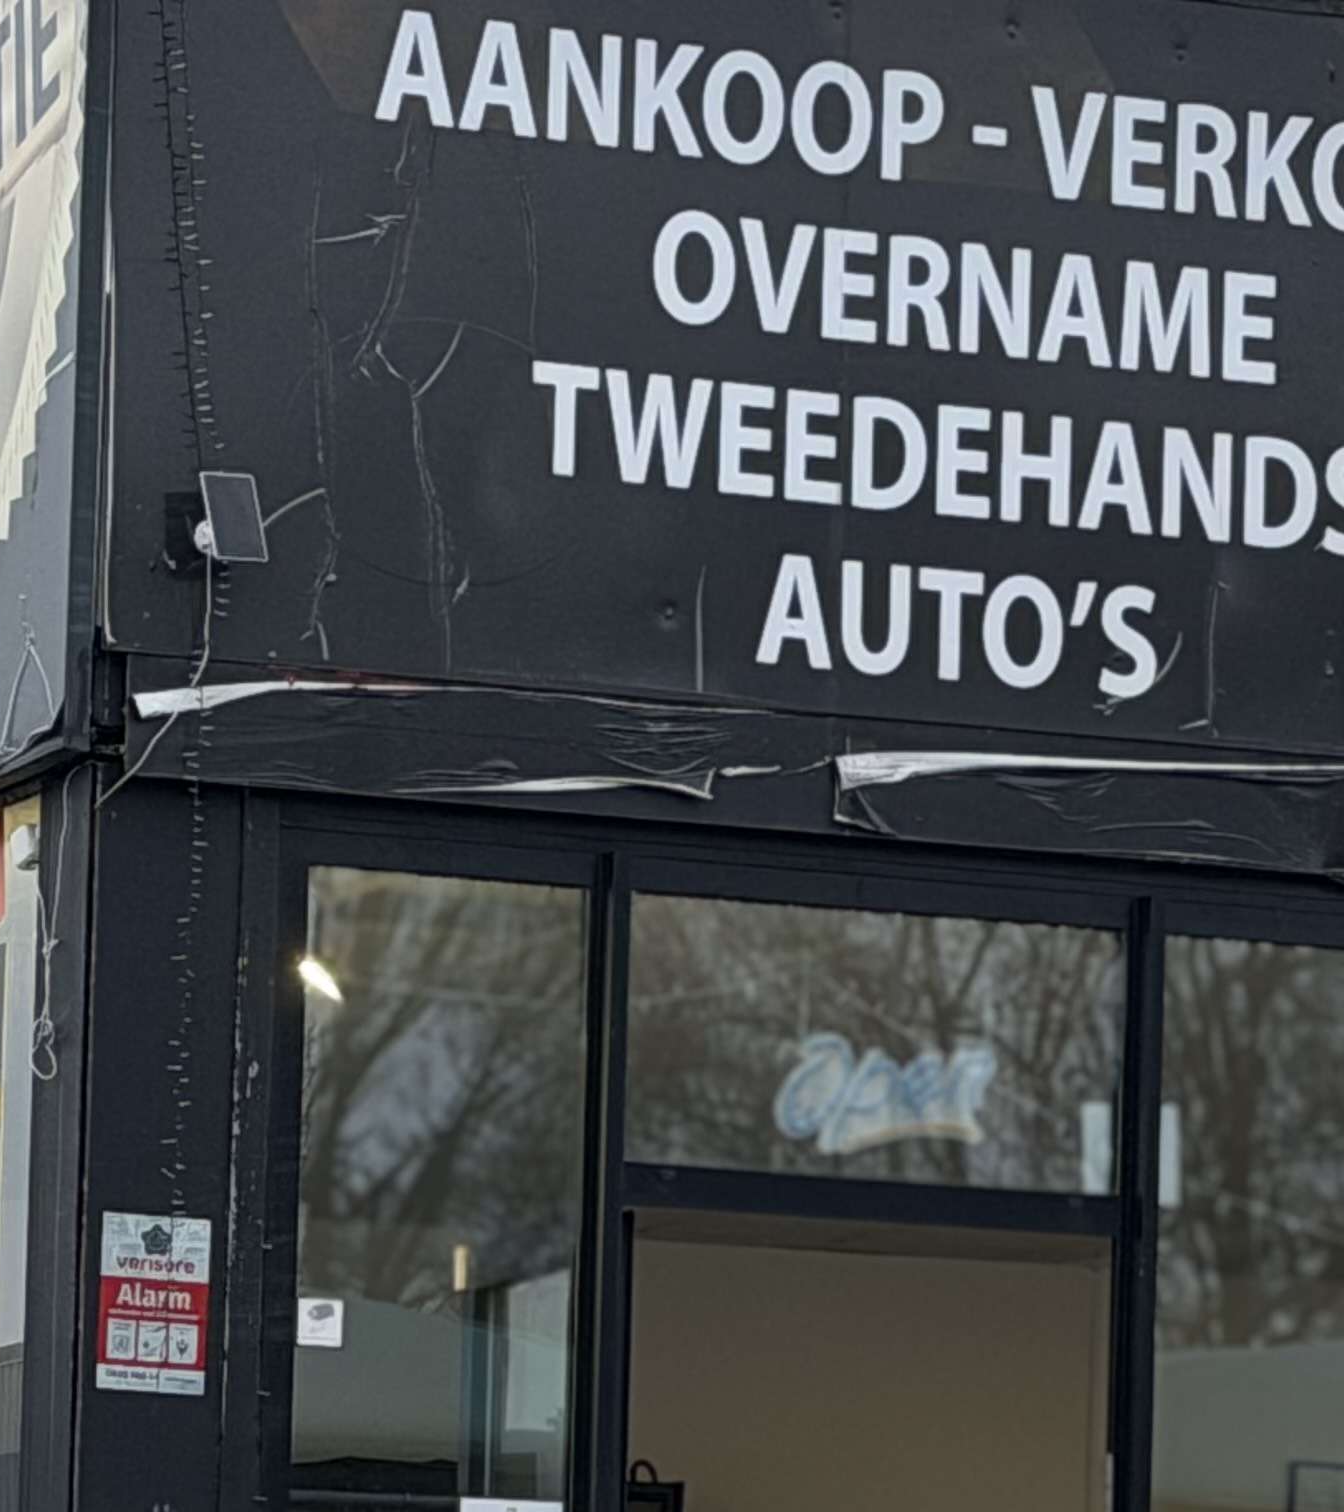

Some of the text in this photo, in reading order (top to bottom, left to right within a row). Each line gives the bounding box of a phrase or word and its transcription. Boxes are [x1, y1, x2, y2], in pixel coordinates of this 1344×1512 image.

[374, 9, 944, 182] AANKOOP
[652, 209, 1277, 385] OVERNAME
[755, 554, 1159, 700] AUTO'S
[116, 1282, 192, 1311] Alarm
